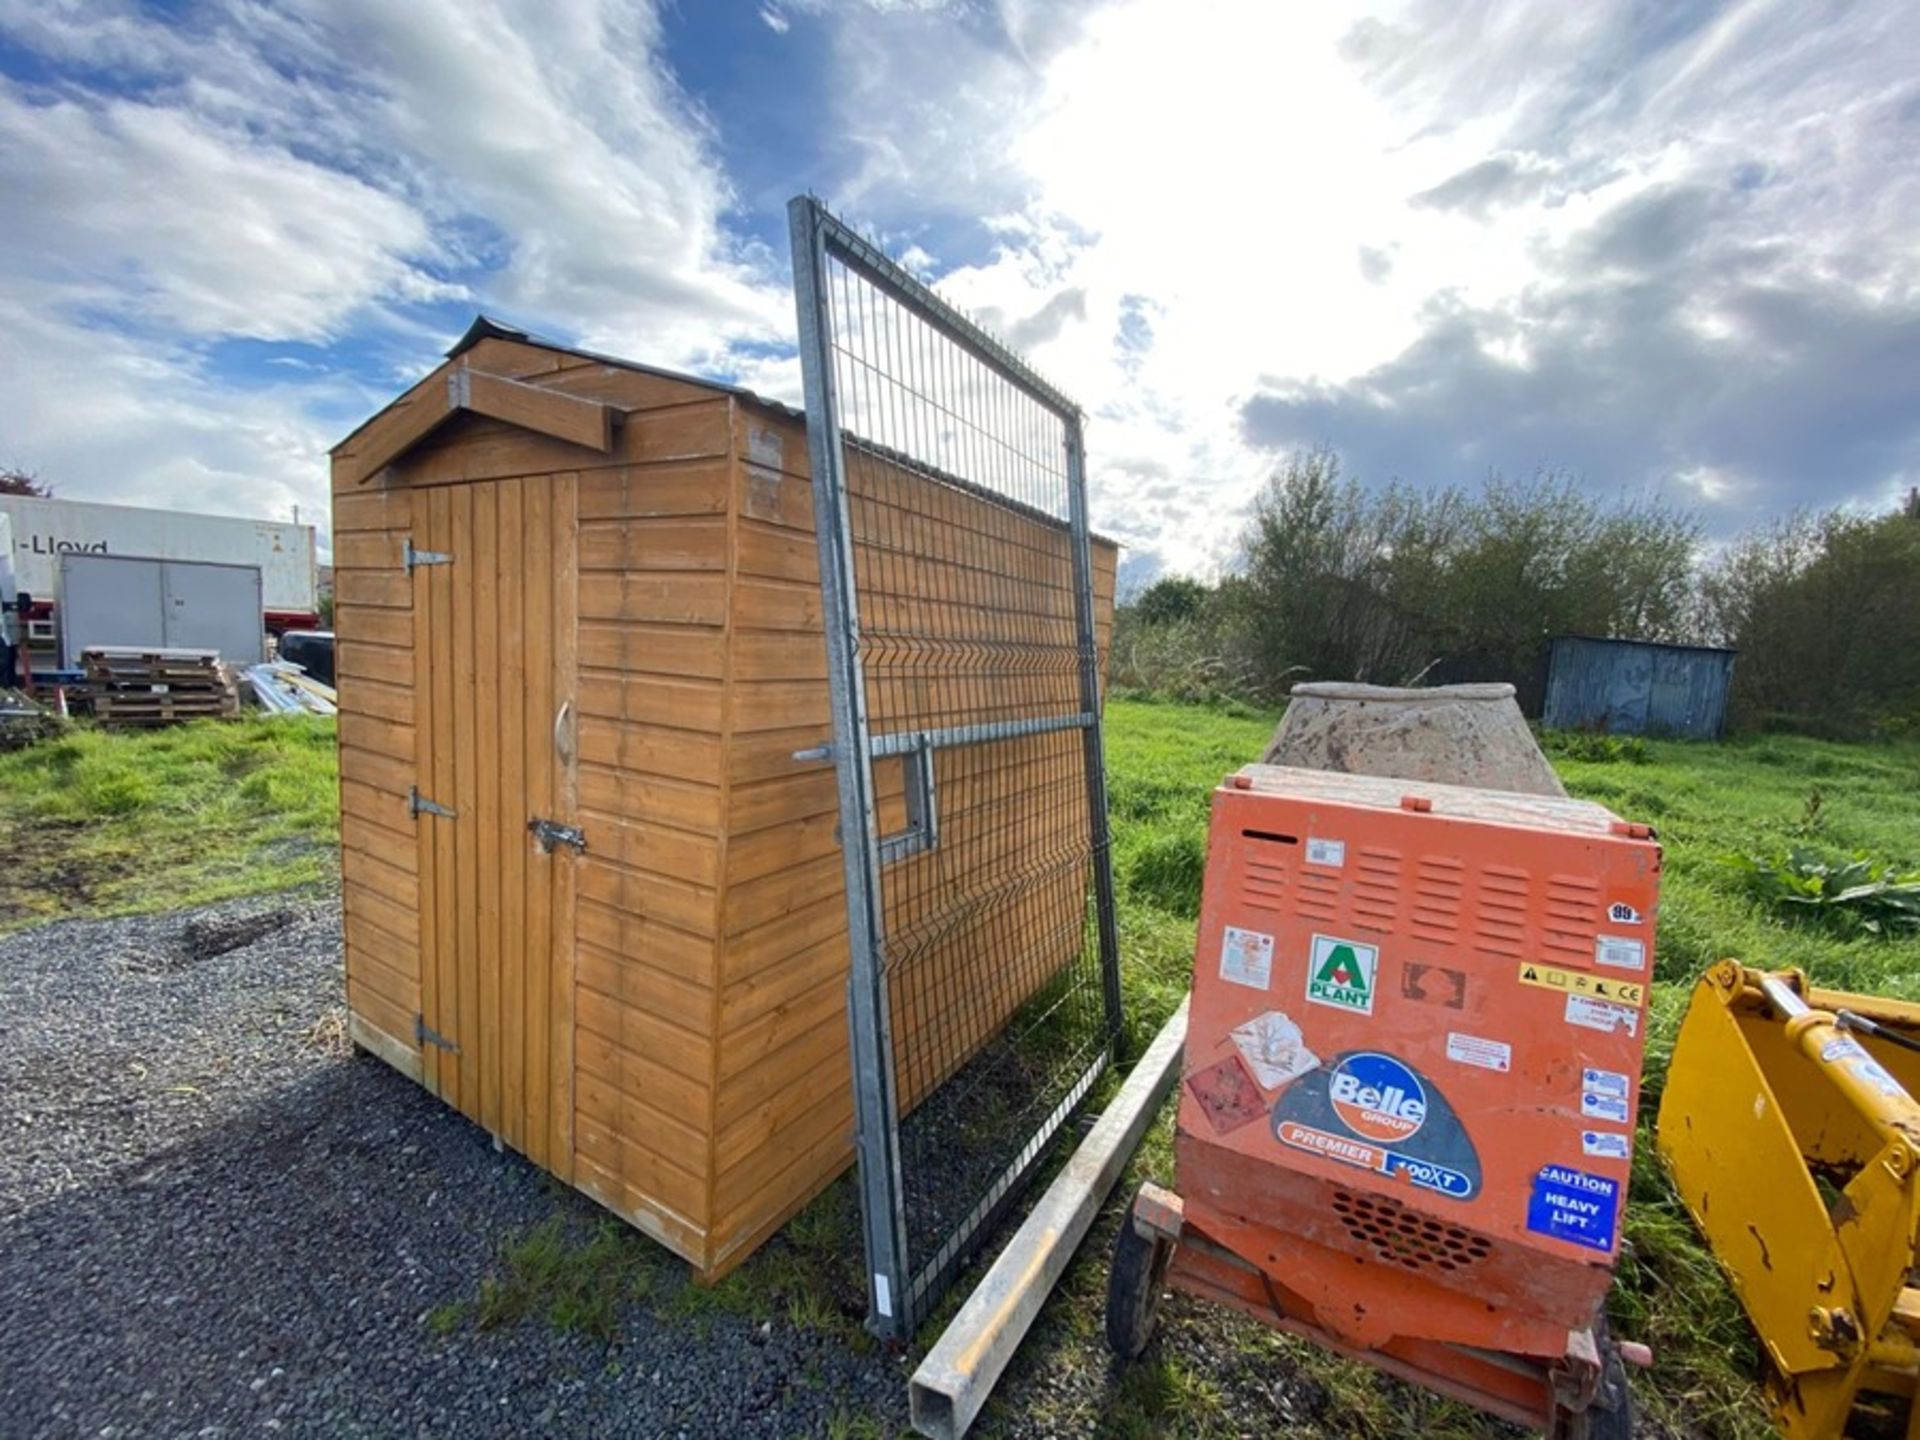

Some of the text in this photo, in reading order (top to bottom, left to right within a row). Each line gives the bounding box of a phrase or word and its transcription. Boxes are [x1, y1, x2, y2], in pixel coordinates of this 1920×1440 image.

[1309, 982, 1370, 1006] PLANT
[1618, 985, 1639, 1002] CE
[1331, 1072, 1425, 1124] Belle
[1361, 1110, 1414, 1131] GROUP
[1291, 1128, 1373, 1162] PREMIER
[1540, 1166, 1613, 1194] CAUTION
[1545, 1191, 1600, 1216] HEAVY
[1552, 1209, 1589, 1229] LIFT
